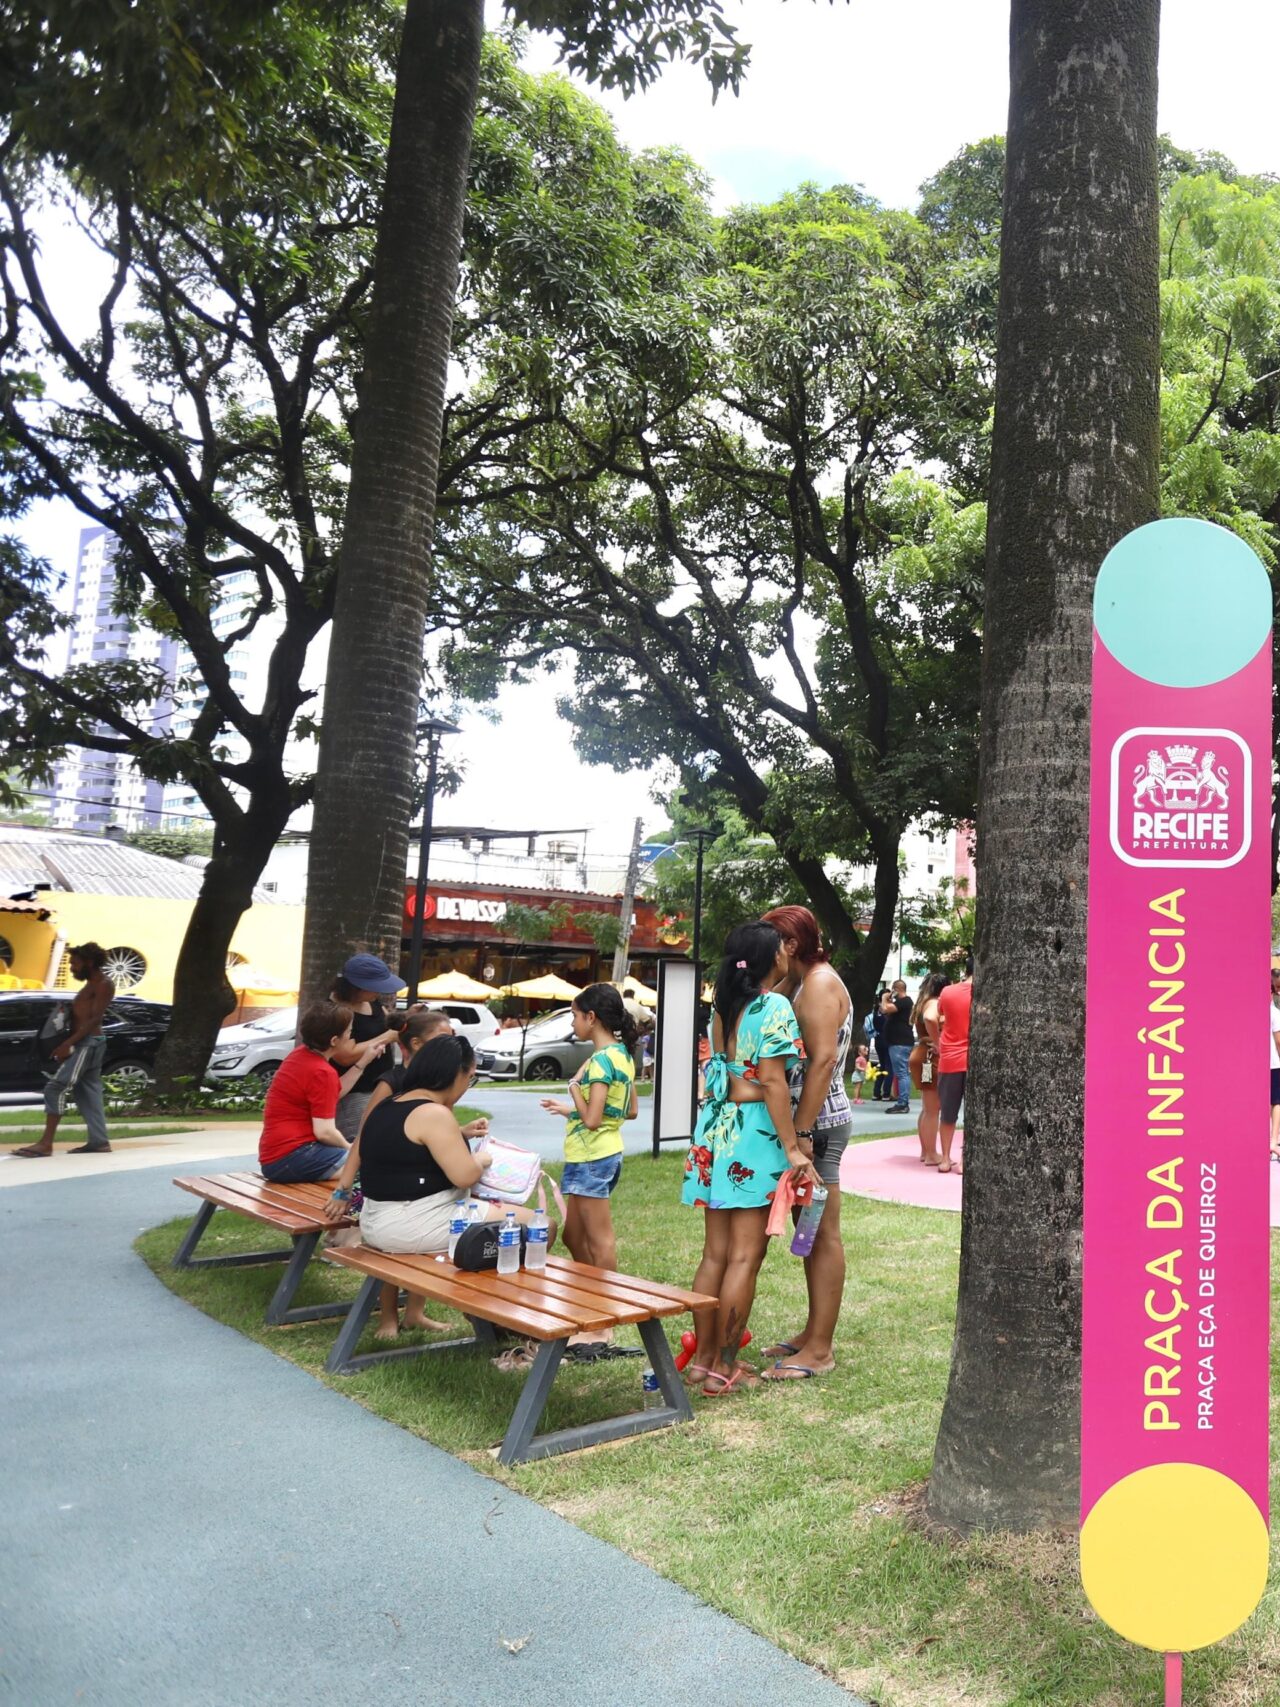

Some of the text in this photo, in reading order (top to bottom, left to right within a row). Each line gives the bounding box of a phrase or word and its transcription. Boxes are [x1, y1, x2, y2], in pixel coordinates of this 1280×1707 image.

[1132, 841, 1229, 850] PREFEITURA
[1133, 812, 1229, 840] RECIFE
[1137, 887, 1190, 1430] PRAÇA DA INFÂNCIA
[1197, 1162, 1218, 1430] PRAÇA EÇA DE QUEIROZ
